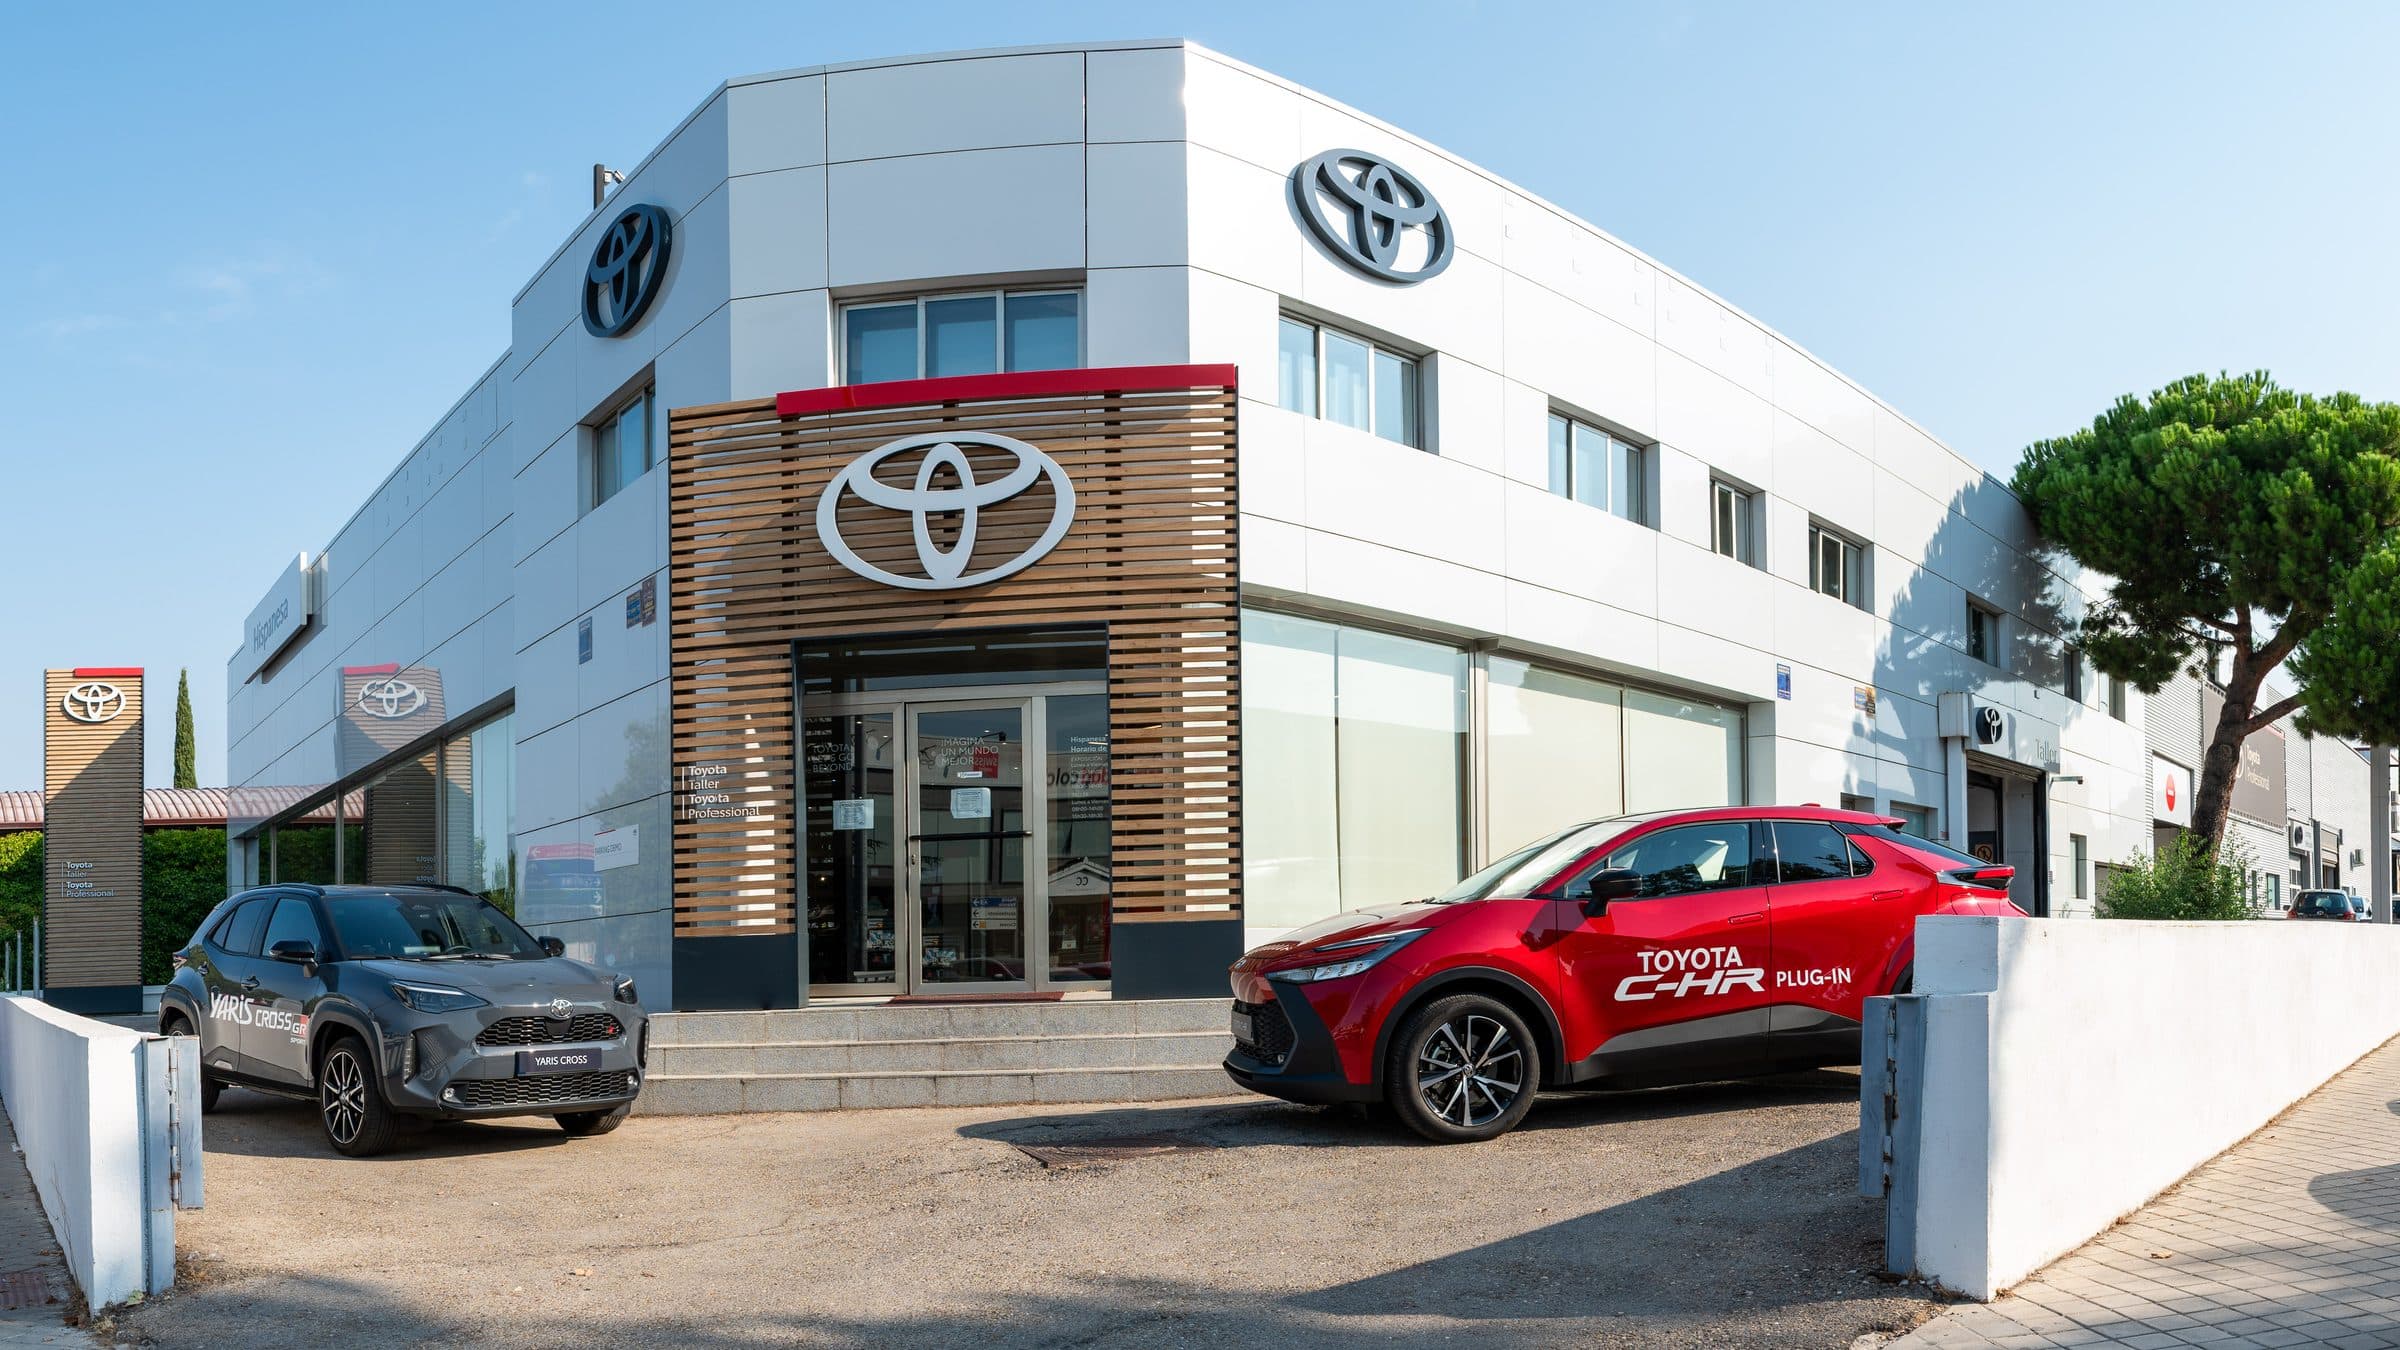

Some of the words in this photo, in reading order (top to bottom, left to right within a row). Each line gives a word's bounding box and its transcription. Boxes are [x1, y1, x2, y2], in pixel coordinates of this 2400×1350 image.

[253, 598, 288, 654] Hispanesa
[941, 736, 985, 747] IMAGINA
[812, 743, 850, 754] TOYOTA
[941, 748, 956, 757] UN
[959, 745, 999, 755] MUNDO
[2035, 738, 2057, 764] Taller
[812, 761, 853, 773] BEYOND
[941, 757, 974, 766] MEJOR
[687, 764, 728, 778] Toyota
[687, 779, 720, 791] Taller
[687, 793, 730, 806] Toyota
[687, 803, 761, 820] Professional
[66, 861, 93, 870] Toyota
[66, 870, 88, 878] Taller
[66, 881, 93, 890] Toyota
[66, 889, 114, 898] Professional
[1637, 946, 1743, 973] TOYOTA
[1776, 967, 1852, 987] PLUG-IN
[1614, 967, 1766, 1001] C-HR
[210, 991, 255, 1026] YARIS
[255, 1009, 293, 1032] CROSS
[292, 1022, 307, 1035] GR
[535, 1056, 559, 1067] YARIS
[560, 1054, 588, 1066] CROSS
